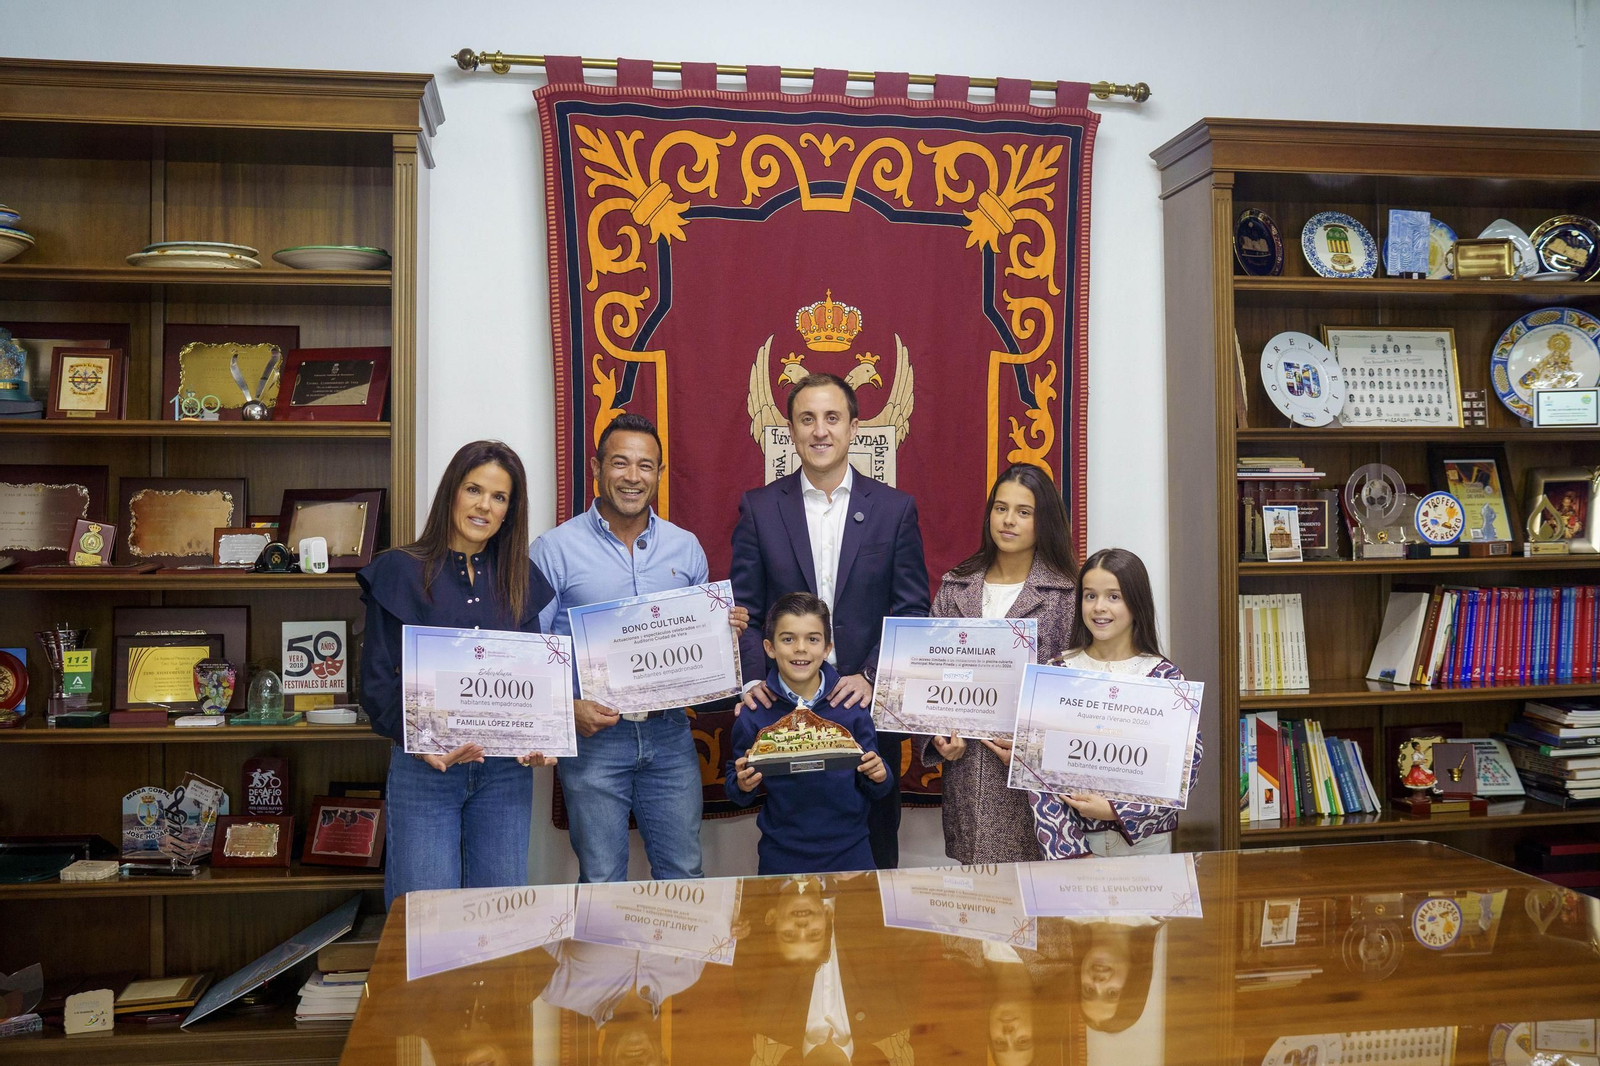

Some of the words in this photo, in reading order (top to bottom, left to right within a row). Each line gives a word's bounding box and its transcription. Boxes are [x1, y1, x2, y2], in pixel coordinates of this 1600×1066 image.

[1426, 497, 1455, 509] TROFEO
[622, 622, 648, 634] BONO
[650, 615, 696, 629] CULTURAL
[614, 635, 639, 643] Actuaciones
[644, 630, 671, 638] espectáculos
[321, 642, 335, 650] AÑOS
[285, 631, 342, 677] 50
[630, 644, 703, 672] 20.000
[633, 670, 662, 680] habitantes
[663, 664, 703, 676] empadronados
[284, 680, 318, 689] FESTIVALES
[321, 680, 328, 688] DE
[330, 680, 344, 688] ARTE
[460, 677, 534, 700] 20.000
[927, 685, 998, 707] 20.000
[926, 705, 954, 713] habitantes
[1059, 697, 1084, 707] PASE
[1086, 700, 1099, 709] DE
[1102, 702, 1164, 717] TEMPORADA
[456, 718, 486, 727] FAMILIA
[488, 718, 510, 728] LÓPEZ
[512, 718, 534, 728] PÉREZ
[1077, 712, 1105, 721] Aquavera
[1068, 739, 1148, 767] 20.000
[1067, 761, 1098, 770] habitantes
[1099, 764, 1143, 775] empadronados
[126, 788, 146, 800] MASA
[148, 788, 170, 800] CORAL
[249, 796, 282, 805] BARIA
